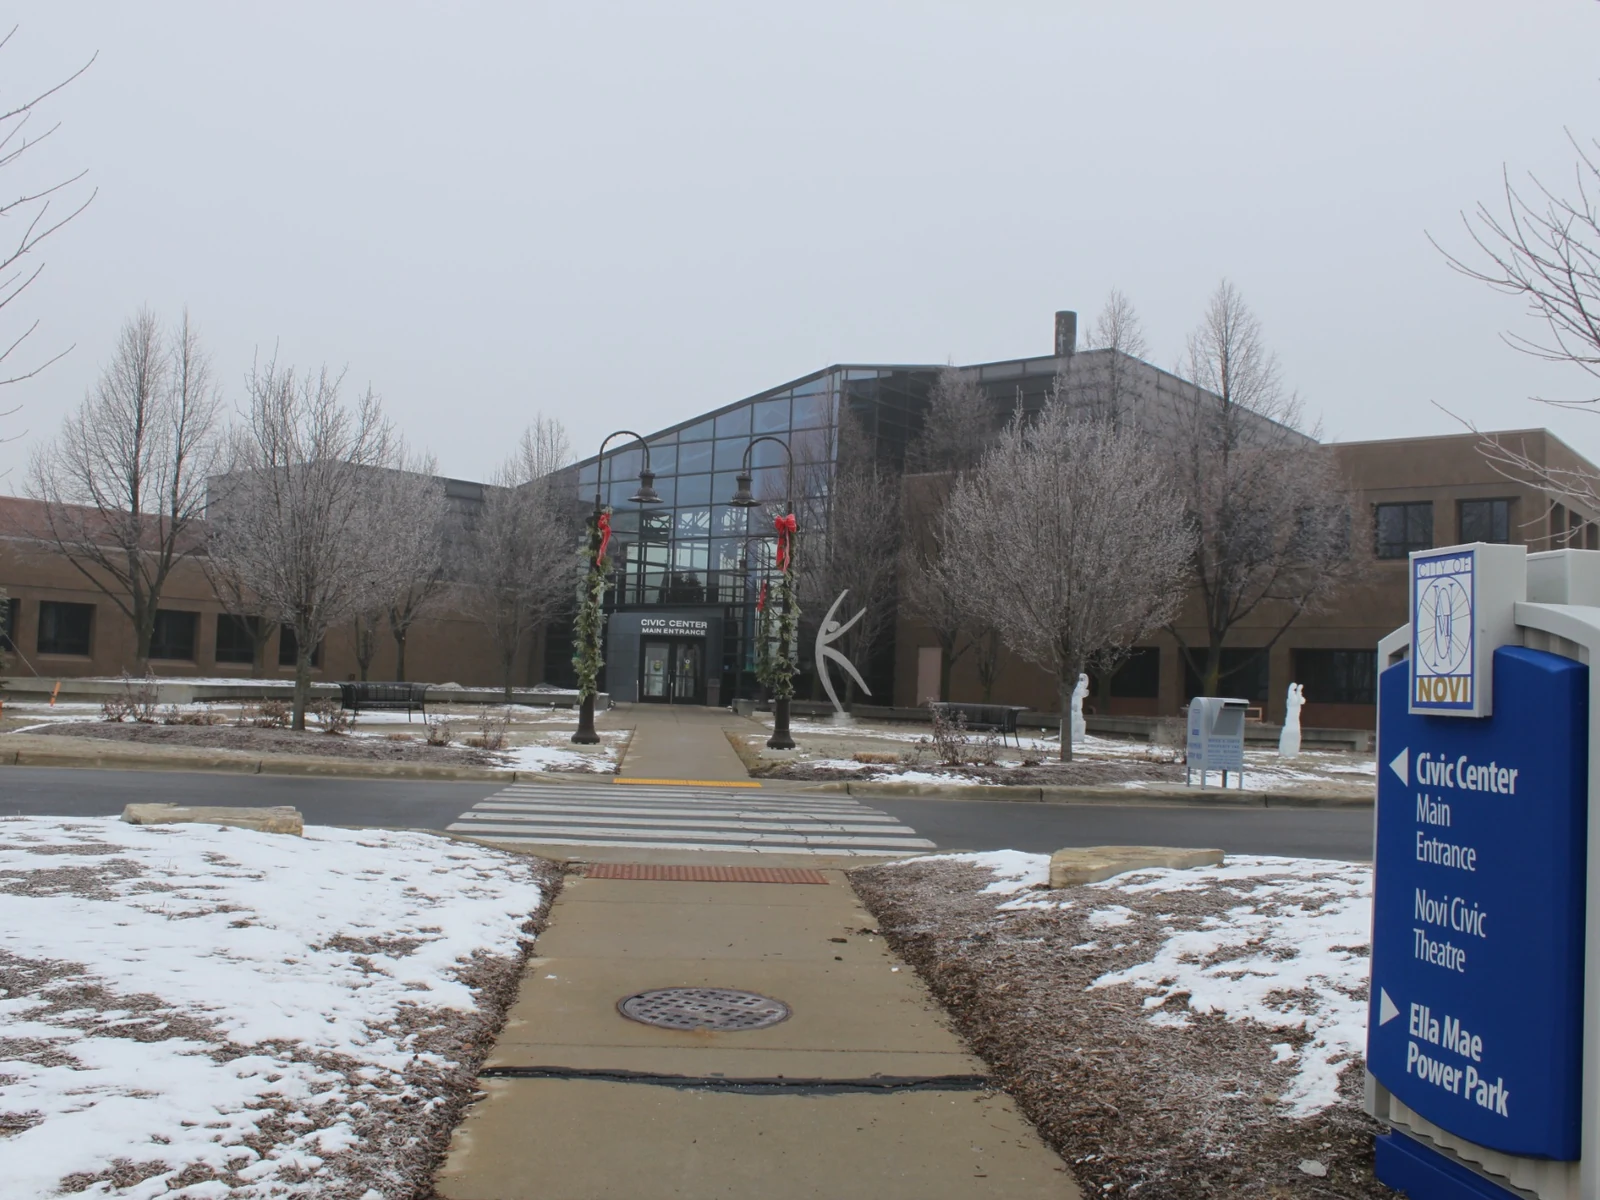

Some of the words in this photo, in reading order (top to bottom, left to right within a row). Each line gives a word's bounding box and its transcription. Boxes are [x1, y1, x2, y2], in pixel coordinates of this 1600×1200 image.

[663, 628, 706, 636] ENTRANCE
[669, 620, 707, 628] CENTER
[1418, 676, 1469, 703] NOVI
[1416, 752, 1454, 788] Civic
[1456, 755, 1518, 795] Center
[1416, 792, 1450, 827] Main
[1416, 831, 1477, 872] Entrance
[1414, 887, 1448, 927] Novi
[1451, 897, 1487, 938] Civic
[1413, 928, 1466, 973] Theatre
[1409, 1002, 1440, 1045] Ella
[1442, 1015, 1483, 1062] Mae
[1406, 1040, 1463, 1094] Power
[1464, 1065, 1510, 1118] Park
